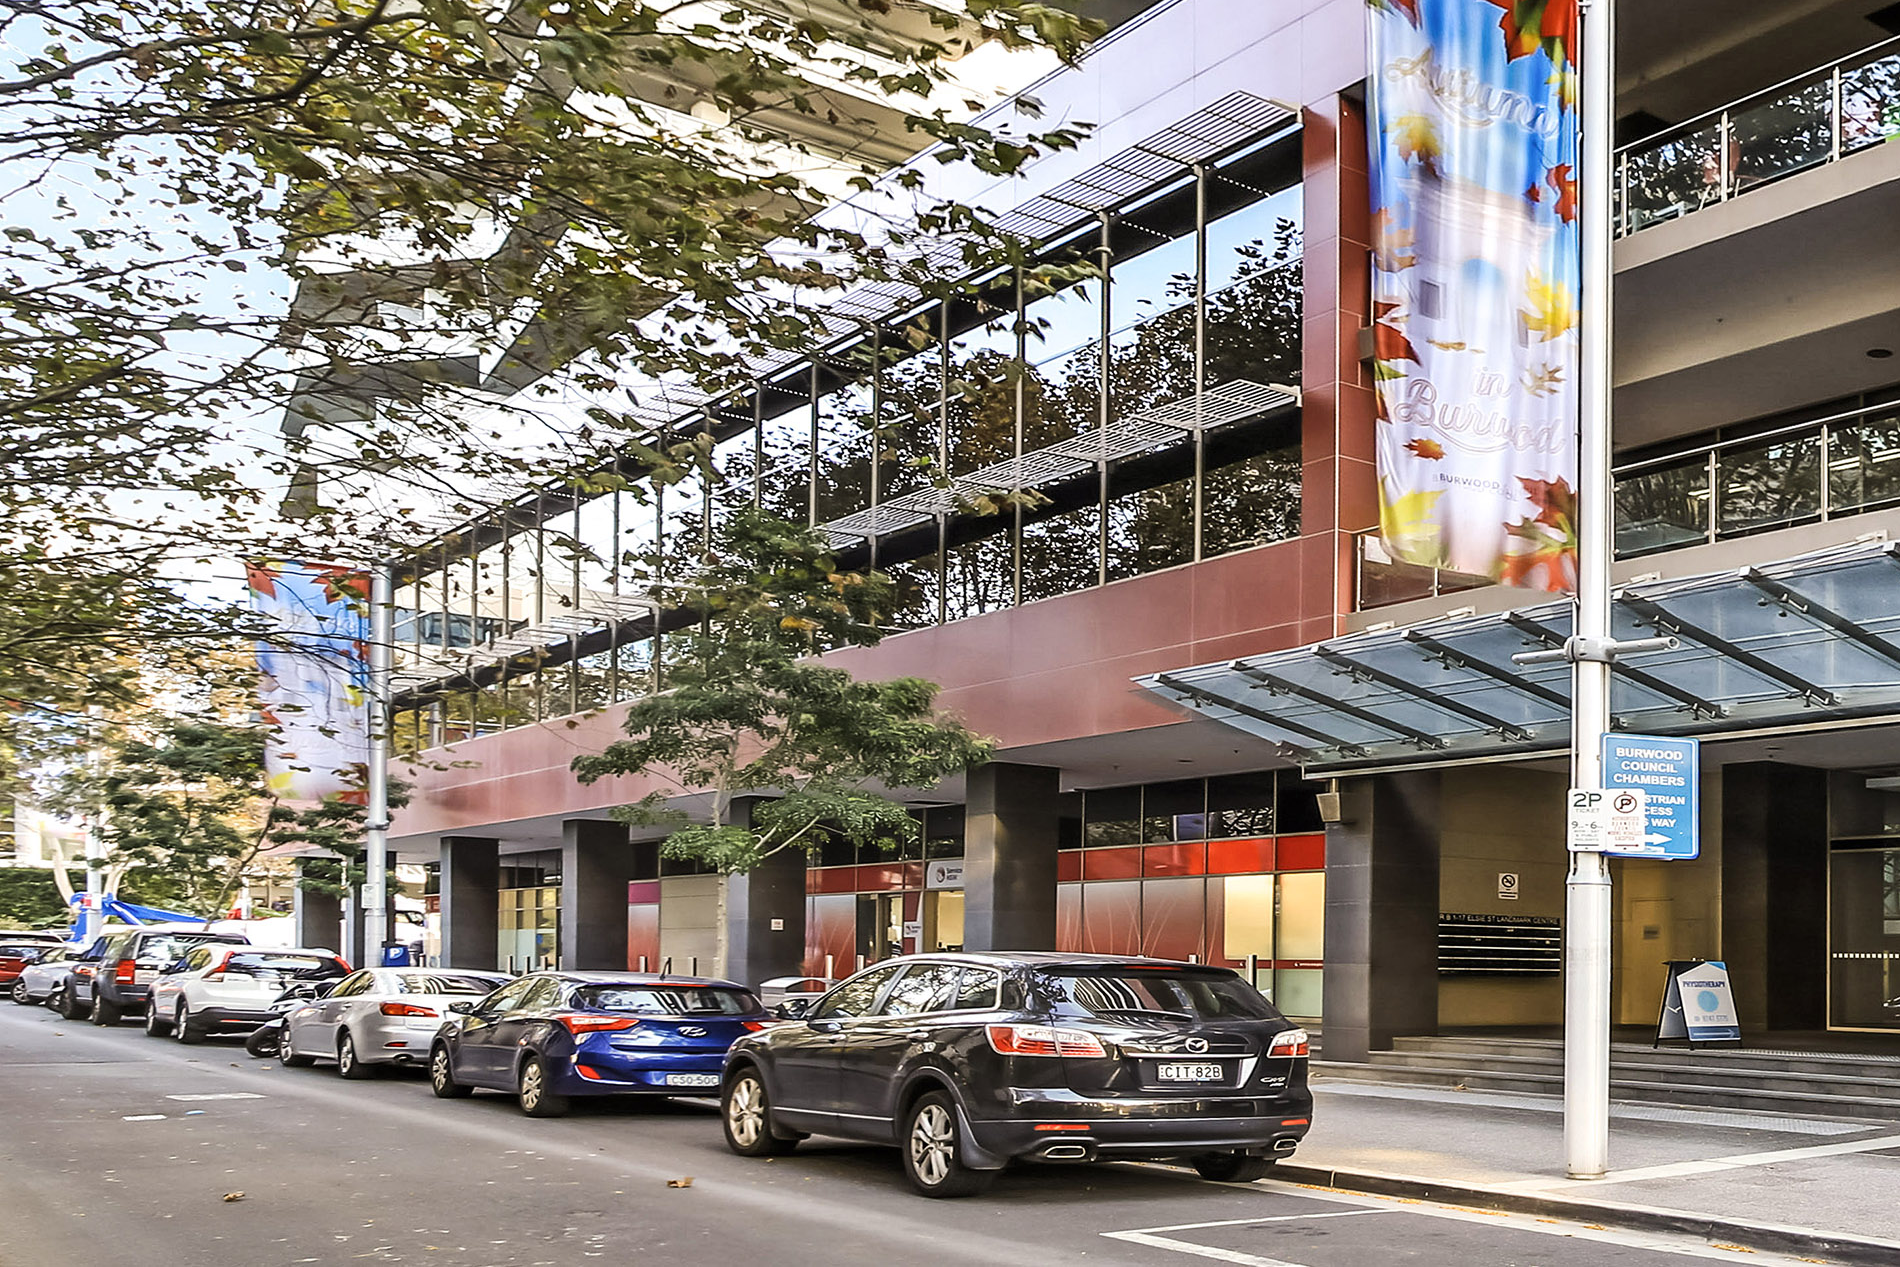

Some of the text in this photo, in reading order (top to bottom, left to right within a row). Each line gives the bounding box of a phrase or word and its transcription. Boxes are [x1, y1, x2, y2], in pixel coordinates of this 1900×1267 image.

[1475, 366, 1512, 398] in
[1616, 747, 1683, 761] BURWOOD
[1621, 760, 1678, 773] COUNCIL
[1613, 773, 1685, 787] CHAMBERS
[1573, 793, 1602, 807] 2P
[1644, 795, 1686, 805] STRIAN
[1644, 806, 1673, 816] CESS
[1651, 817, 1677, 828] WAY
